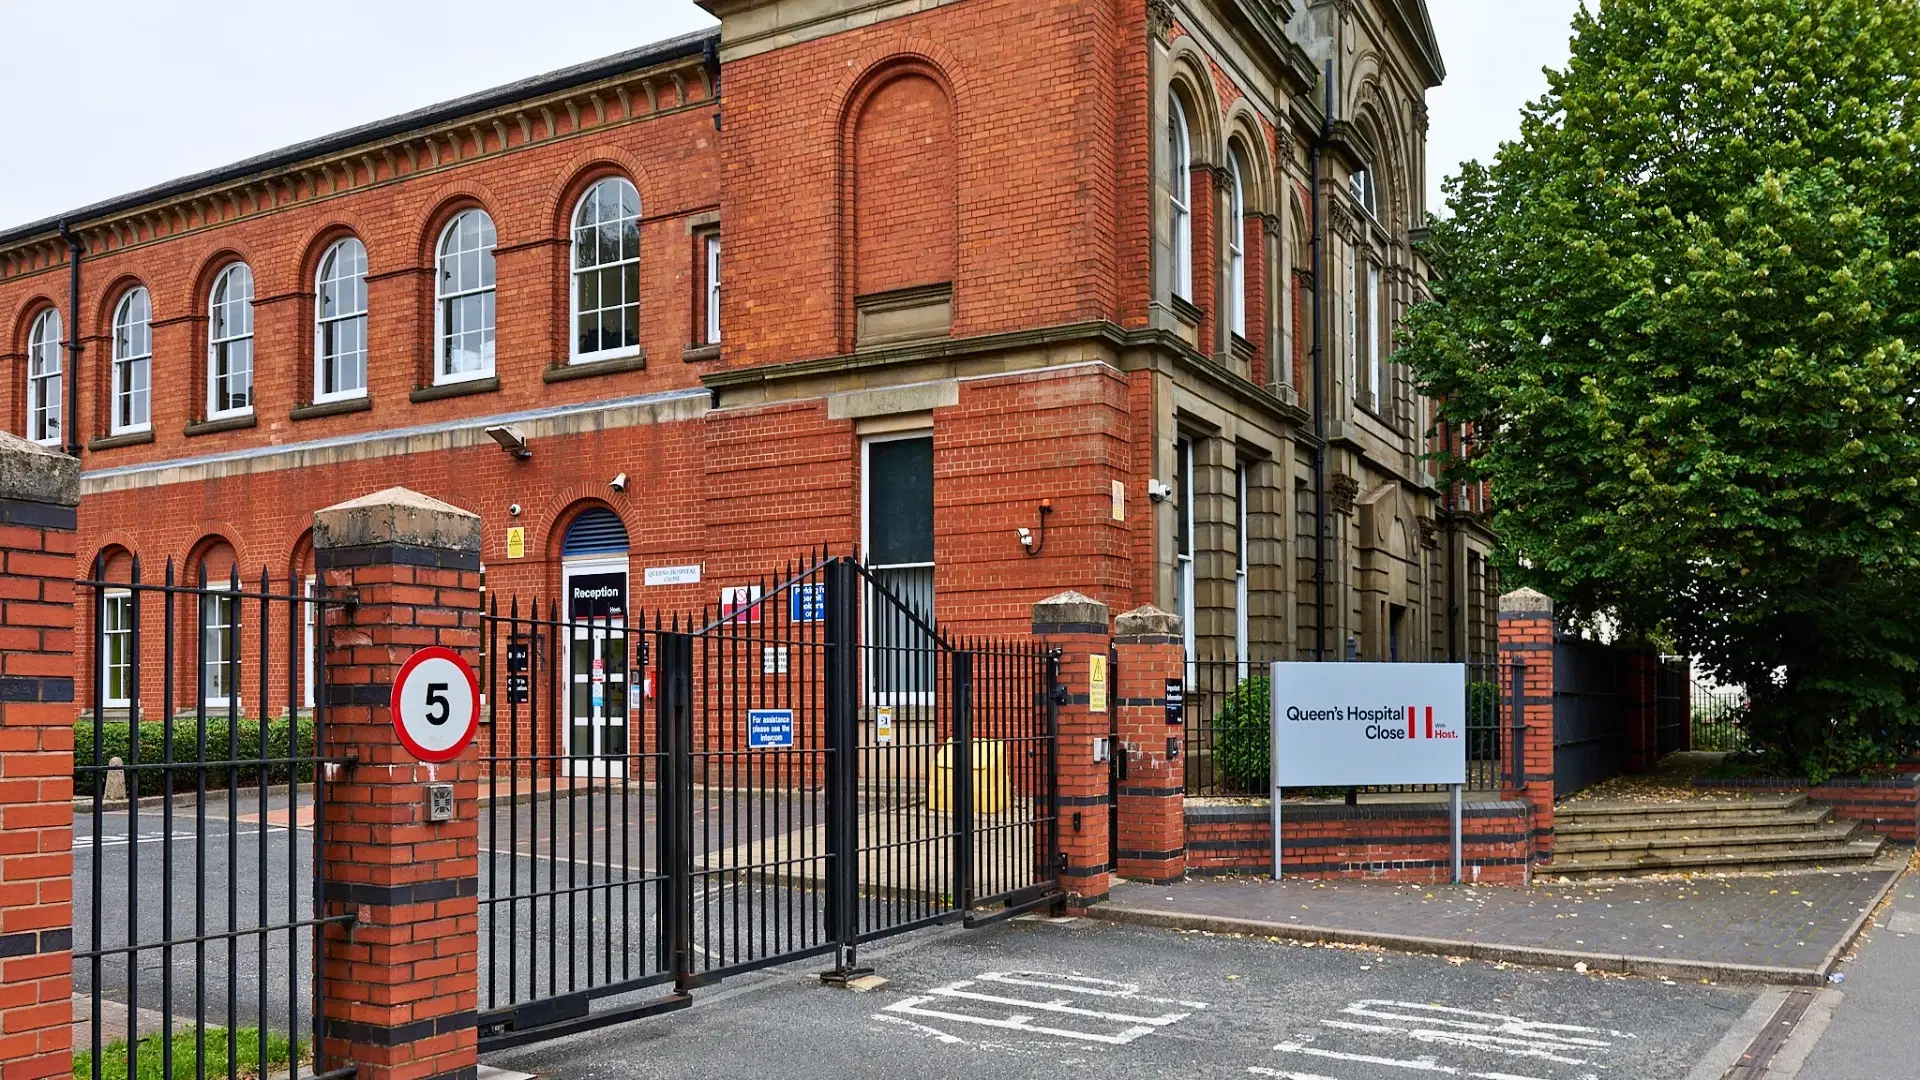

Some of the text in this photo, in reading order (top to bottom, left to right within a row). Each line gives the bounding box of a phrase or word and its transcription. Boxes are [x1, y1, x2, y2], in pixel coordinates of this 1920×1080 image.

[574, 585, 618, 600] Reception
[425, 683, 450, 726] 5
[752, 715, 790, 724] For assistance
[1286, 705, 1404, 723] Queen's Hospital
[752, 725, 770, 734] please
[782, 724, 790, 732] the
[1365, 725, 1405, 740] Close
[1435, 730, 1459, 739] Host.
